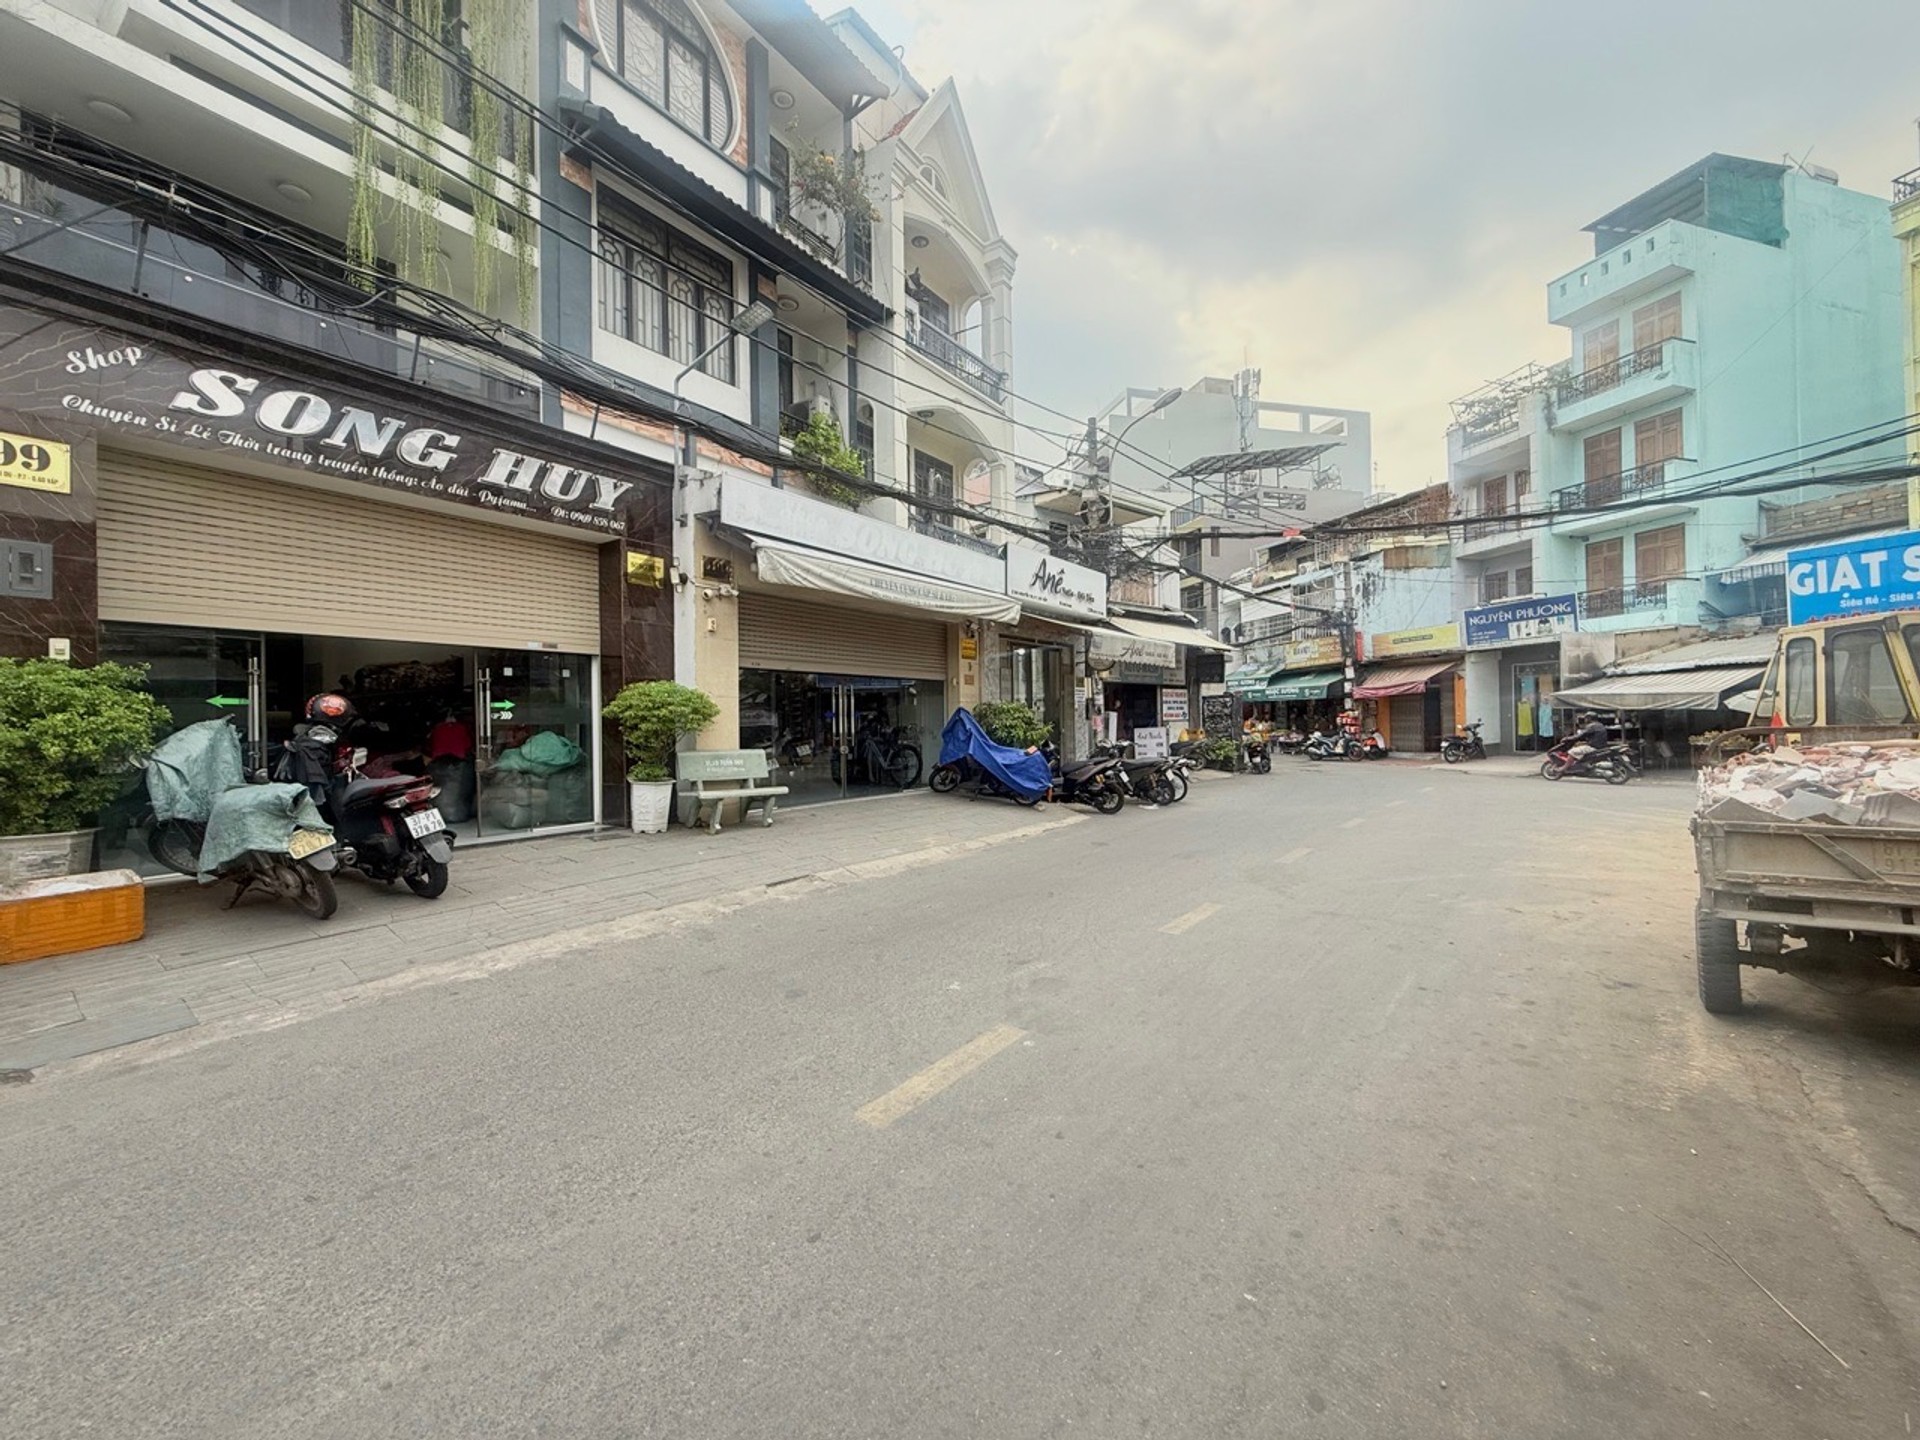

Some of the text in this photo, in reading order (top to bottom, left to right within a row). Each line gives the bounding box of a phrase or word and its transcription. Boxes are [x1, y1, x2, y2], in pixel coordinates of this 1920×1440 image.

[66, 346, 142, 374] Shop
[62, 394, 149, 428] Chuyên
[266, 442, 313, 465] trang
[168, 368, 633, 512] SONG HUY
